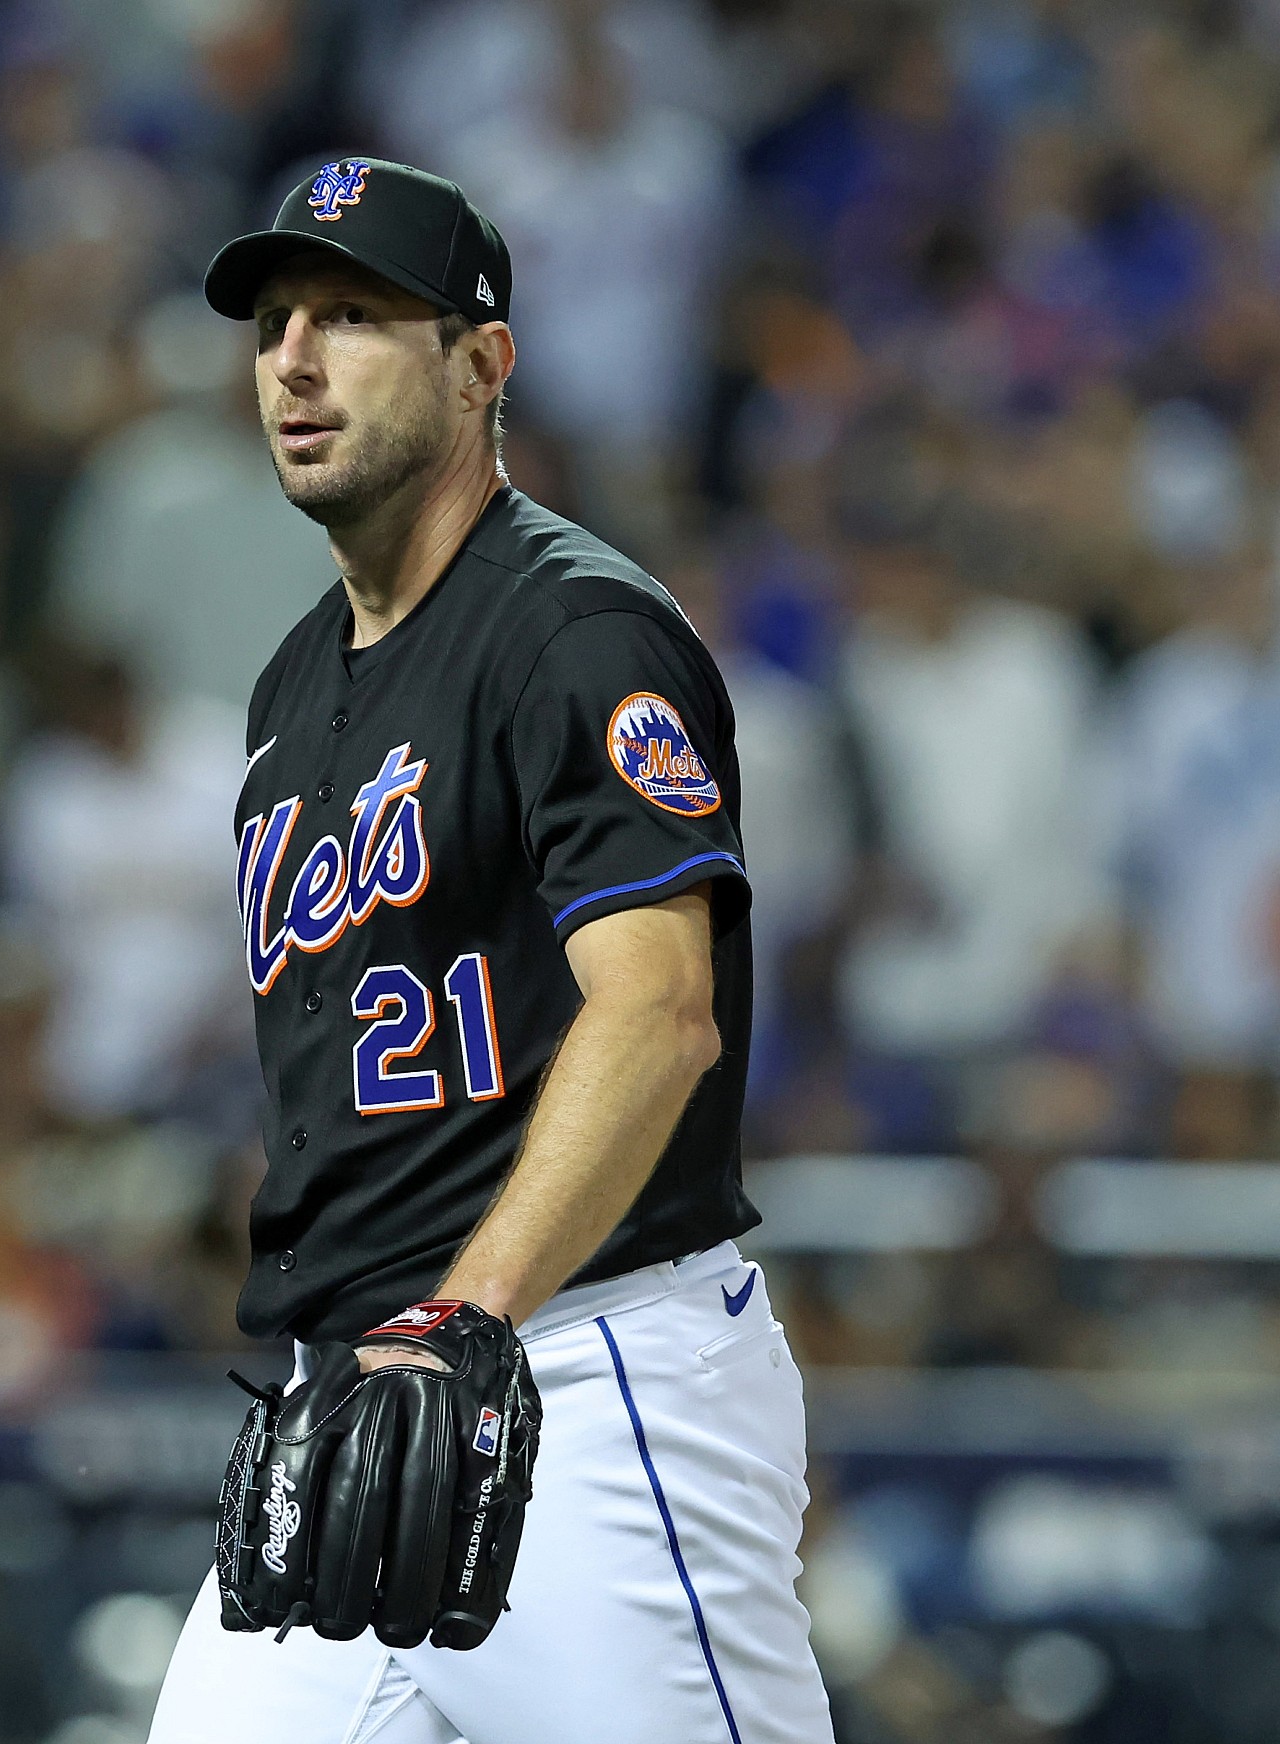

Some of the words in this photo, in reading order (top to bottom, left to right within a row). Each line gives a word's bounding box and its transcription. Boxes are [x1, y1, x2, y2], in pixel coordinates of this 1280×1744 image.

[638, 738, 706, 781] Mets
[351, 952, 505, 1116] 21
[262, 1459, 297, 1574] Rawlings
[465, 1534, 480, 1568] GOLD
[459, 1568, 474, 1594] THE
